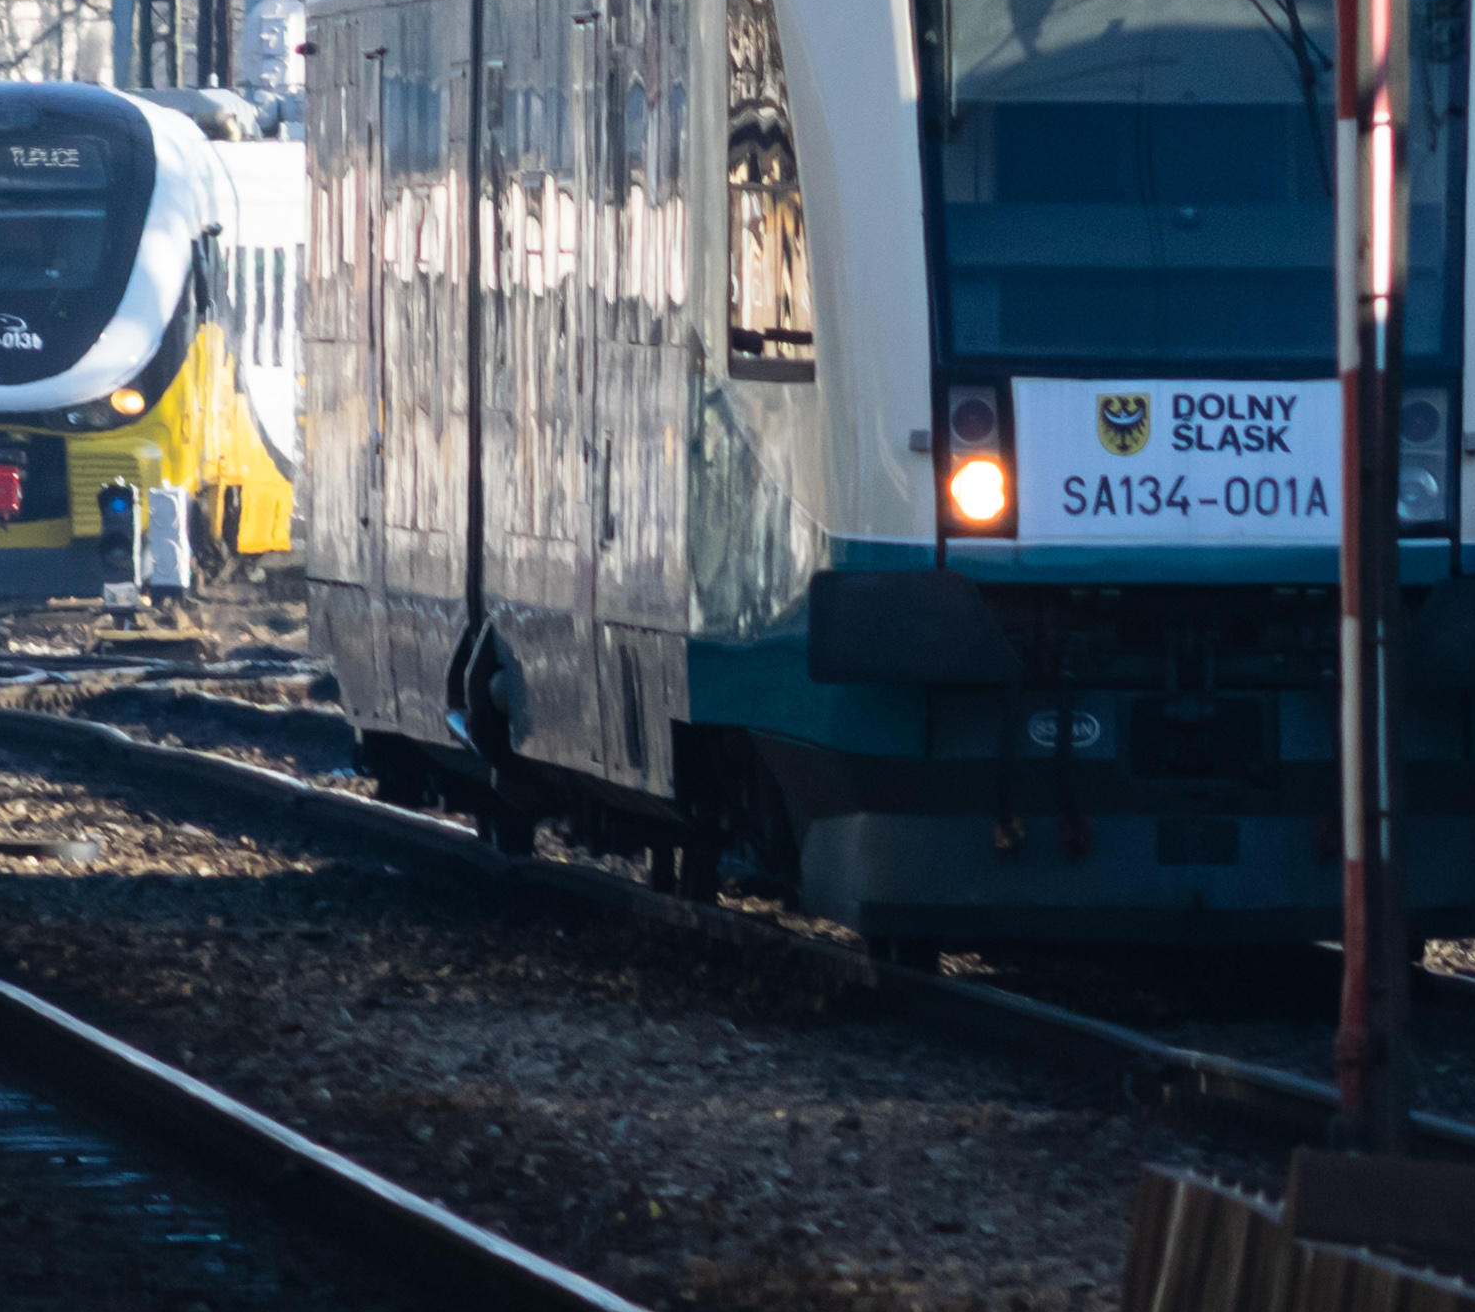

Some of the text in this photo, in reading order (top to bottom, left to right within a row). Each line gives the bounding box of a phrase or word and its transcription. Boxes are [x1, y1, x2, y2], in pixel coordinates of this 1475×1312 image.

[1171, 393, 1298, 421] DOLNY
[1171, 417, 1292, 456] ŚLĄSK
[1062, 474, 1330, 517] SA134-001A
